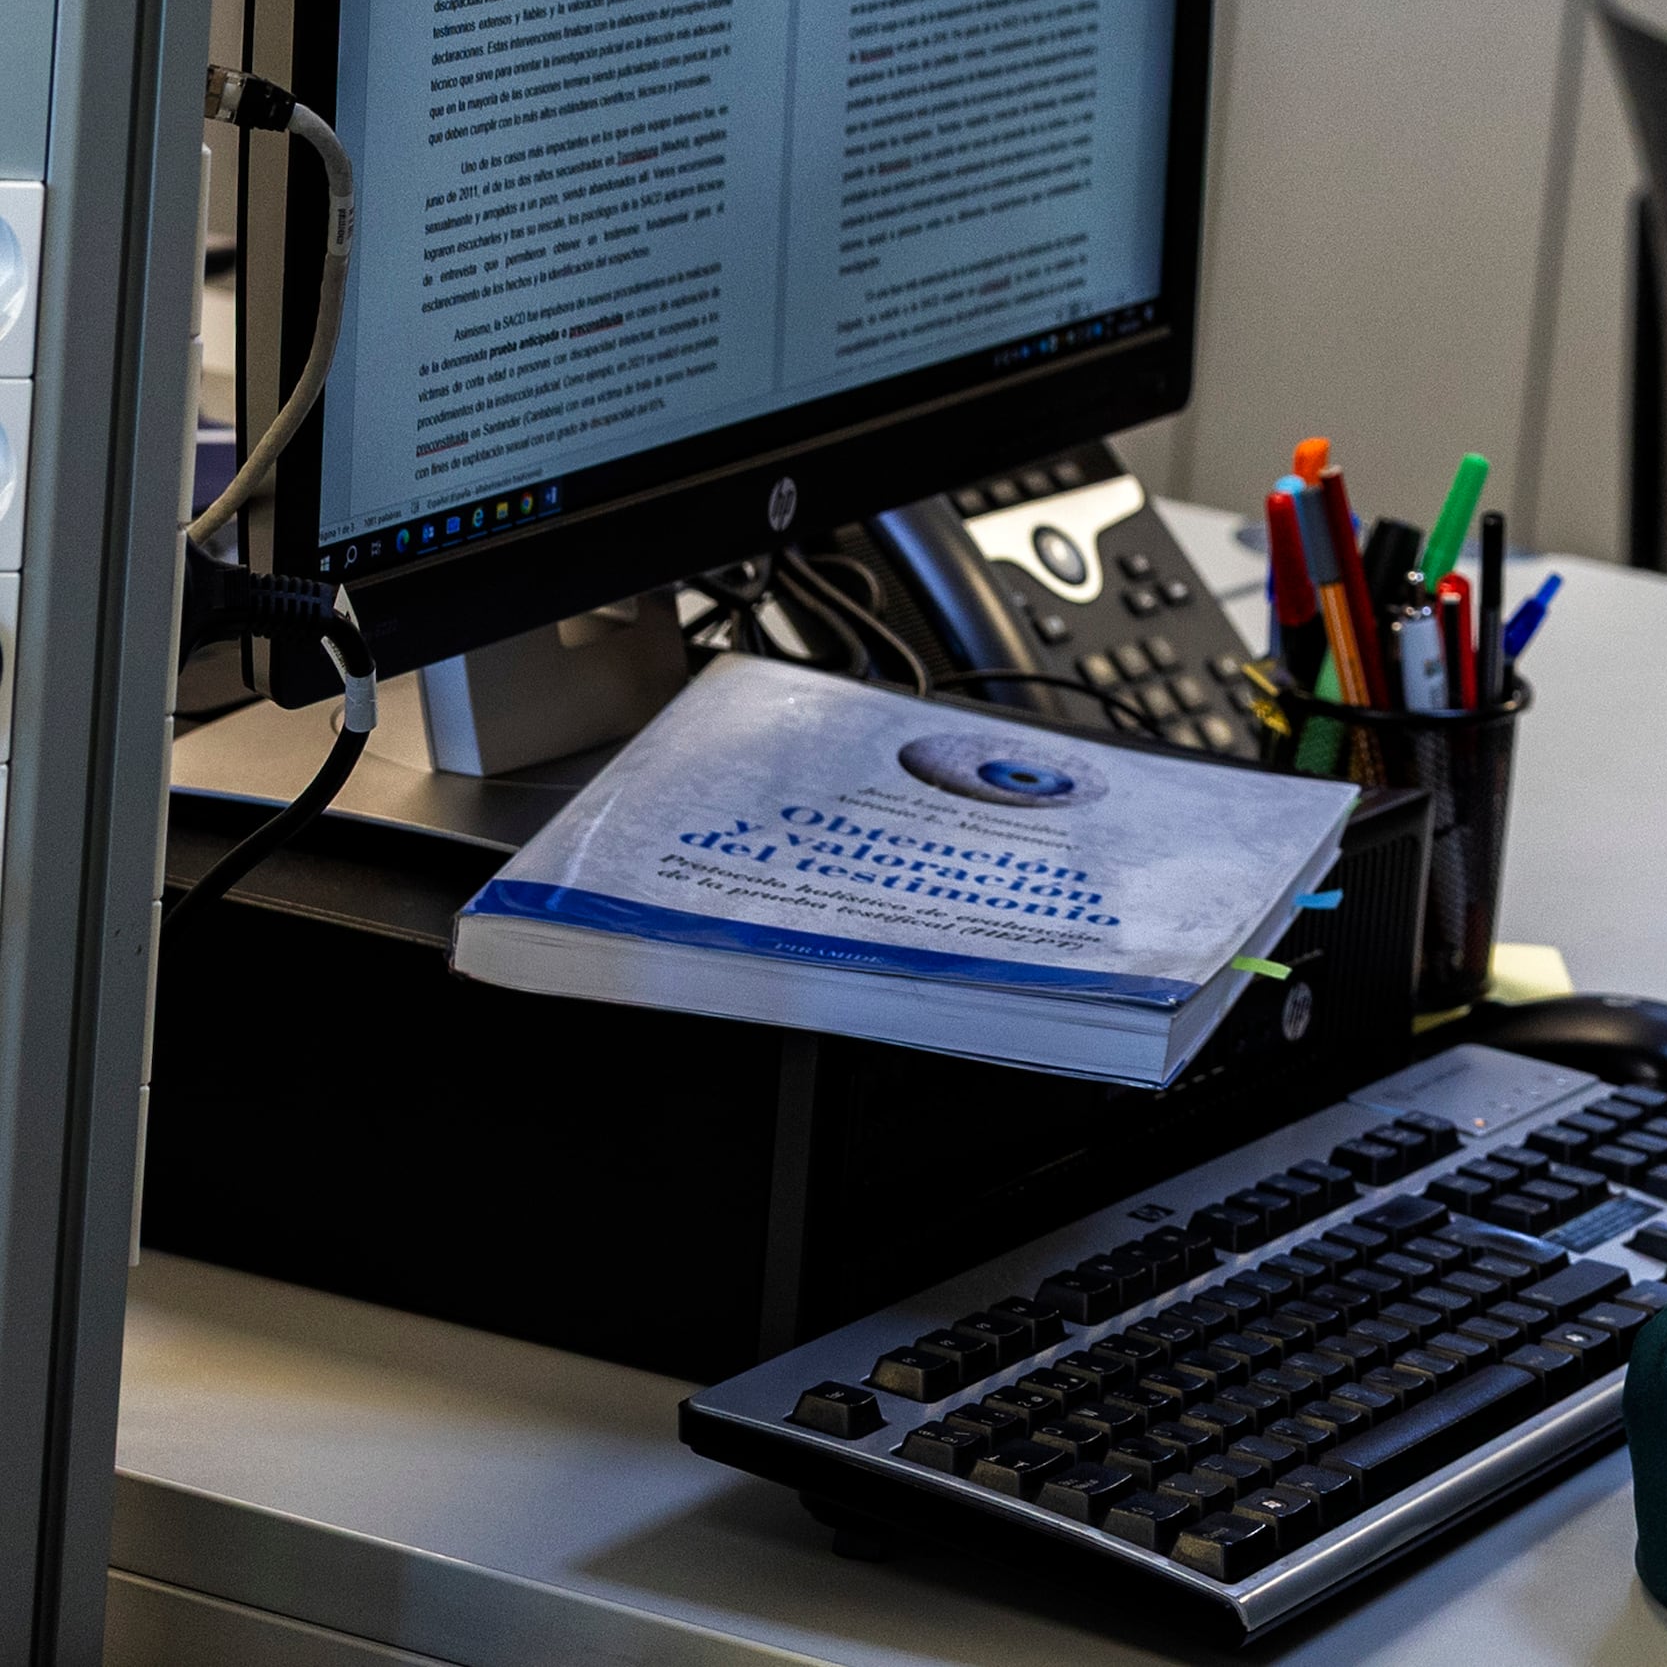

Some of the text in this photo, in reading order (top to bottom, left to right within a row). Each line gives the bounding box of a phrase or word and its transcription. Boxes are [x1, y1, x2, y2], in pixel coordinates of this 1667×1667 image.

[433, 14, 511, 38] testimonios extensos
[487, 41, 507, 54] Estas
[459, 74, 473, 87] que
[475, 70, 492, 82] sirve
[495, 66, 511, 79] para
[429, 106, 443, 119] que
[446, 103, 455, 114] en
[458, 100, 465, 111] la
[500, 91, 509, 102] de
[428, 117, 512, 146] que deben cumplir con
[461, 156, 501, 174] Uno de los
[425, 195, 444, 210] junio
[446, 191, 456, 203] de
[482, 182, 489, 194] el
[492, 181, 501, 192] de
[425, 214, 472, 234] sexualmente
[424, 233, 501, 261] lograron escucharles
[422, 259, 498, 286] de entrevista que
[421, 283, 503, 313] esclarecimiento de los
[494, 320, 500, 330] la
[503, 311, 525, 328] SACD
[419, 364, 428, 376] de
[431, 361, 438, 372] la
[441, 349, 486, 370] denominada
[489, 341, 516, 359] prueba
[452, 381, 462, 393] de
[465, 376, 484, 389] corta
[417, 398, 493, 430] procedimientos de la
[416, 417, 520, 455] preconstituida en Santander
[414, 458, 460, 479] con fines de
[780, 805, 1088, 883] Obtención
[724, 819, 1103, 905] y valoración
[679, 831, 1121, 927] del testimonio
[656, 868, 1084, 951] de la prueba testifical (HELPT)
[659, 853, 1103, 944] Protocolo holístico de evaluación
